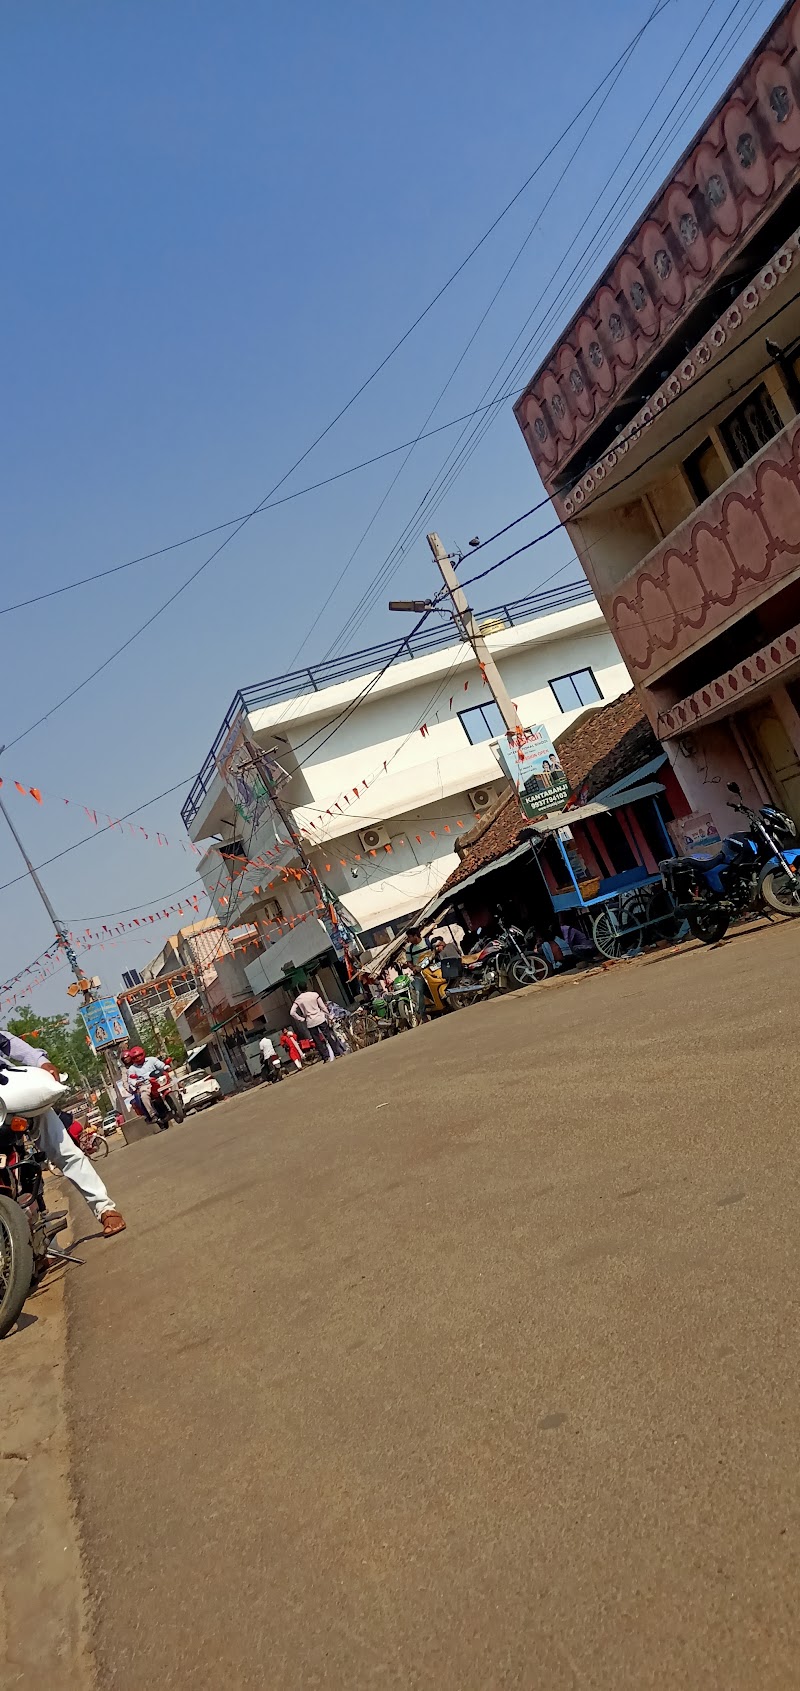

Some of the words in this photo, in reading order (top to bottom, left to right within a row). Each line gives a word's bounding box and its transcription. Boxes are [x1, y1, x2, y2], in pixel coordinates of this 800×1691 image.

[507, 745, 534, 756] INTERTIONAL
[515, 754, 537, 764] ADSSION
[525, 784, 568, 804] KANTABANJI
[531, 792, 567, 809] 9937794103
